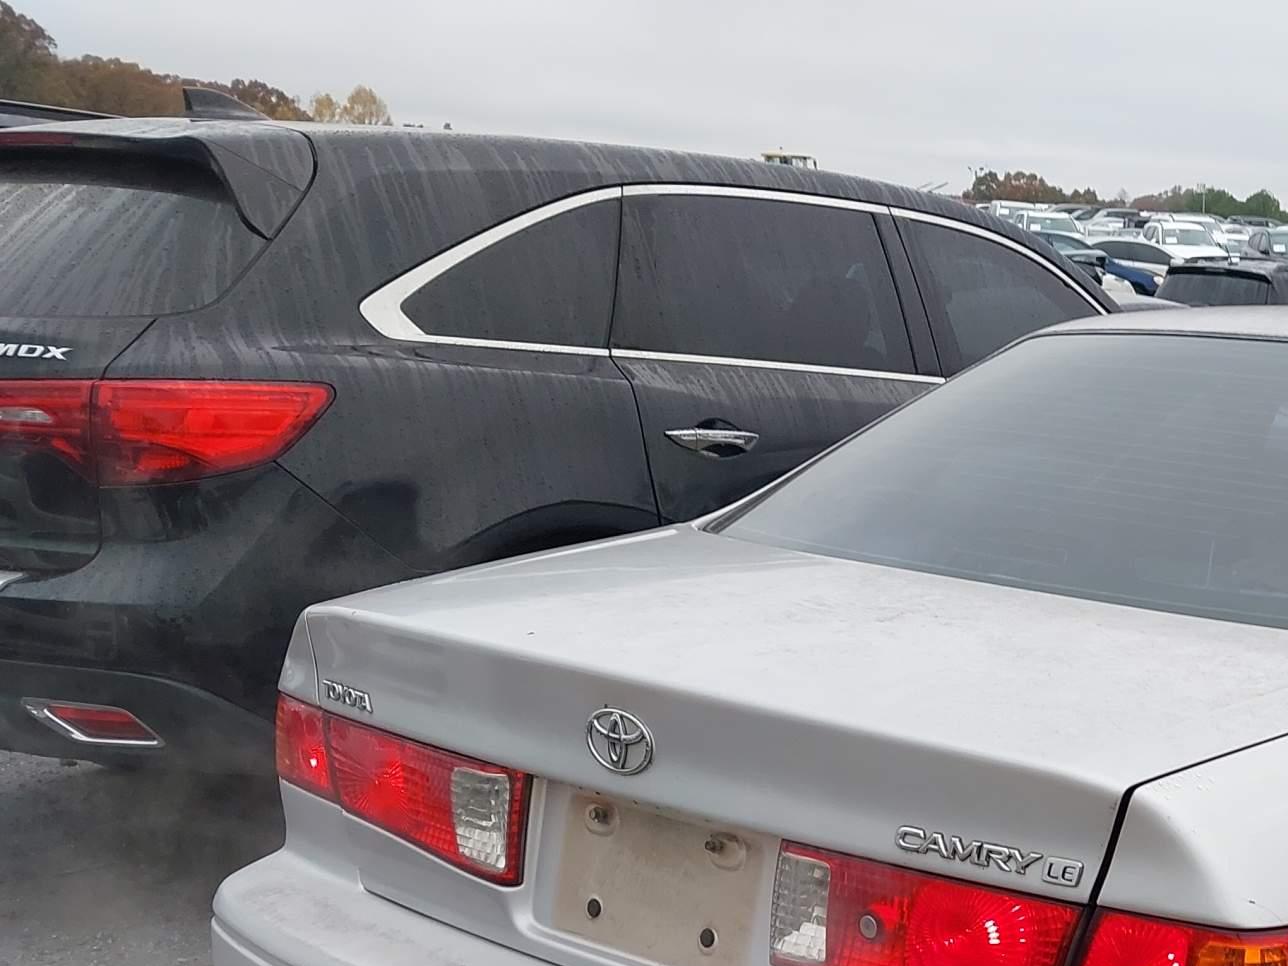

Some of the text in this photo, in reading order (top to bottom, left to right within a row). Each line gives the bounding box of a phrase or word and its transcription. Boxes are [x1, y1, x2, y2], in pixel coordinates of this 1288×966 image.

[0, 343, 74, 361] MDX
[322, 679, 373, 713] TOYOTA
[895, 825, 1078, 883] CAMRY LE
